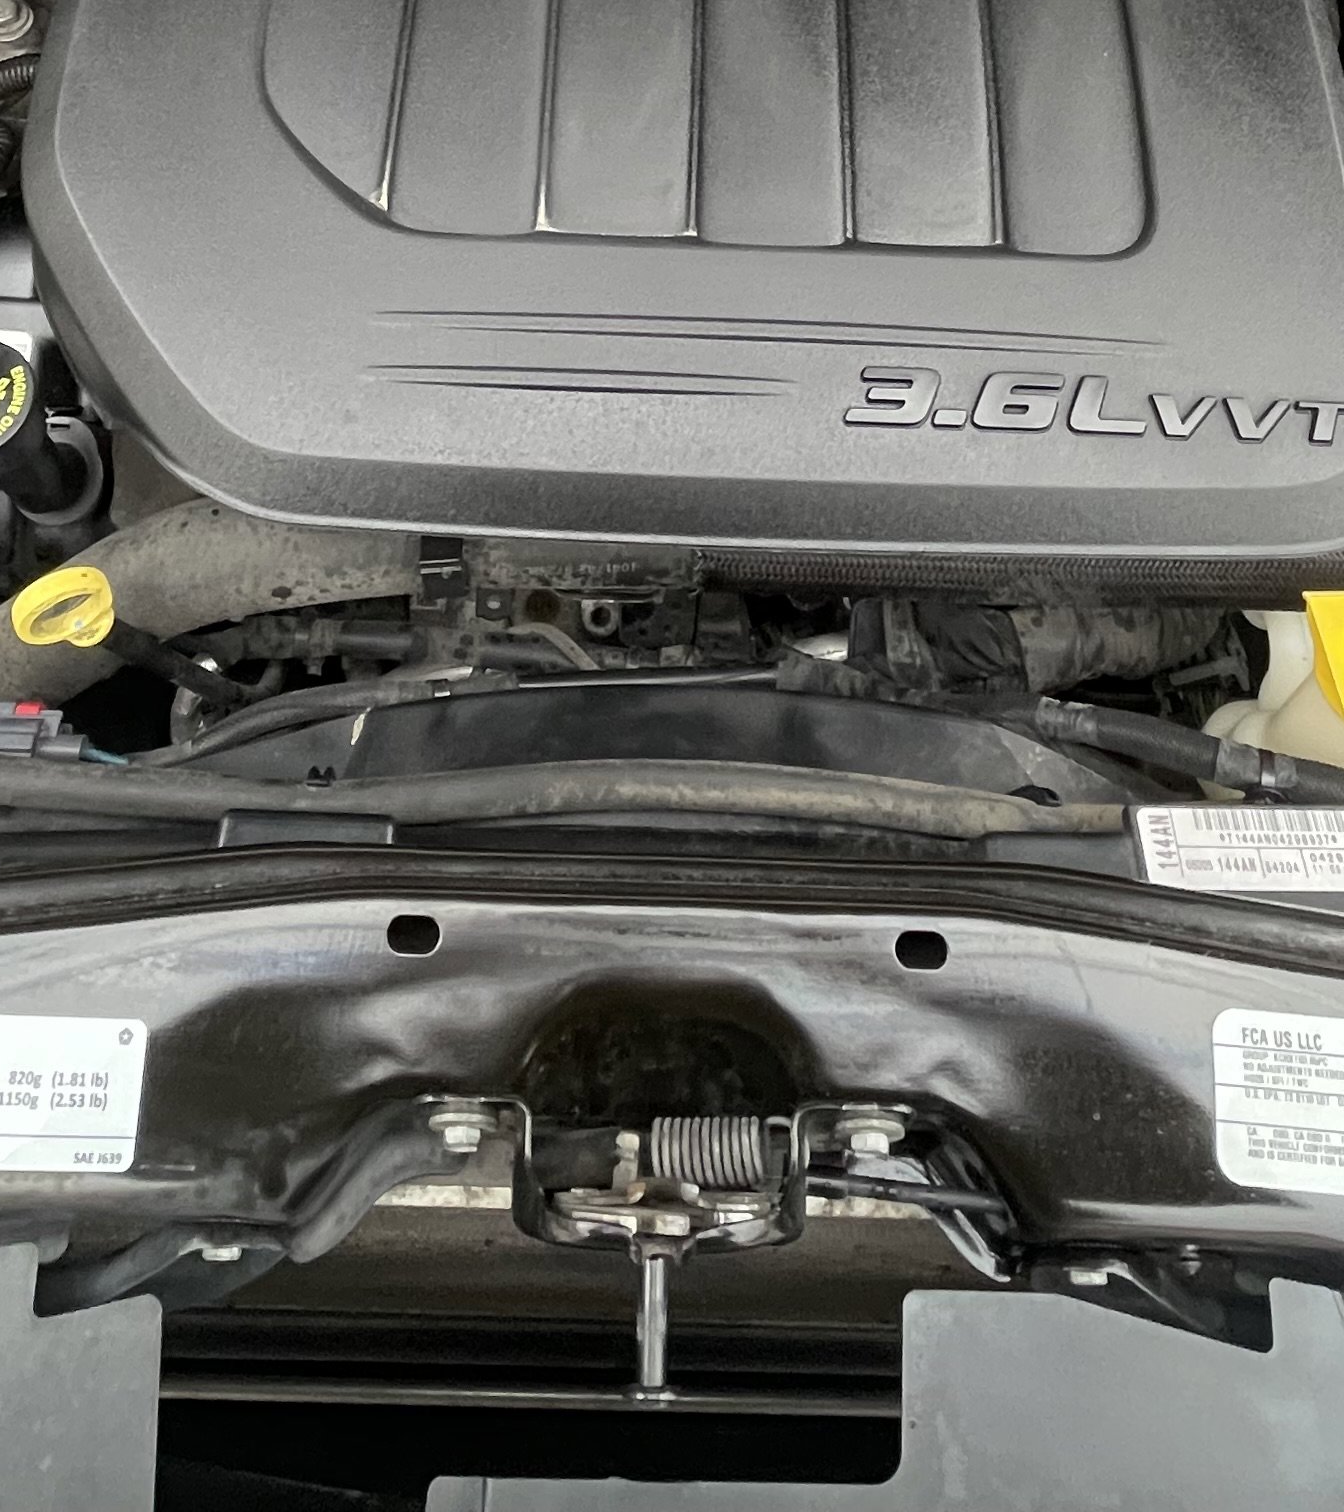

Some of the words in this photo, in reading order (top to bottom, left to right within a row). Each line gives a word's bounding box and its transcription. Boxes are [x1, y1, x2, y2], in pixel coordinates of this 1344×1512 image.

[6, 365, 27, 416] ENGINE
[1147, 814, 1179, 869] 144AN
[1218, 856, 1257, 873] 144AN
[1241, 1026, 1269, 1047] FCA
[1273, 1030, 1294, 1050] US
[1297, 1032, 1323, 1052] LLC
[8, 1070, 43, 1089] 820g
[52, 1070, 86, 1089] (1.81
[90, 1072, 109, 1090] lb)
[50, 1092, 85, 1111] (2.53
[89, 1093, 108, 1112] lb)
[73, 1152, 95, 1165] SAE
[97, 1152, 123, 1165] J639
